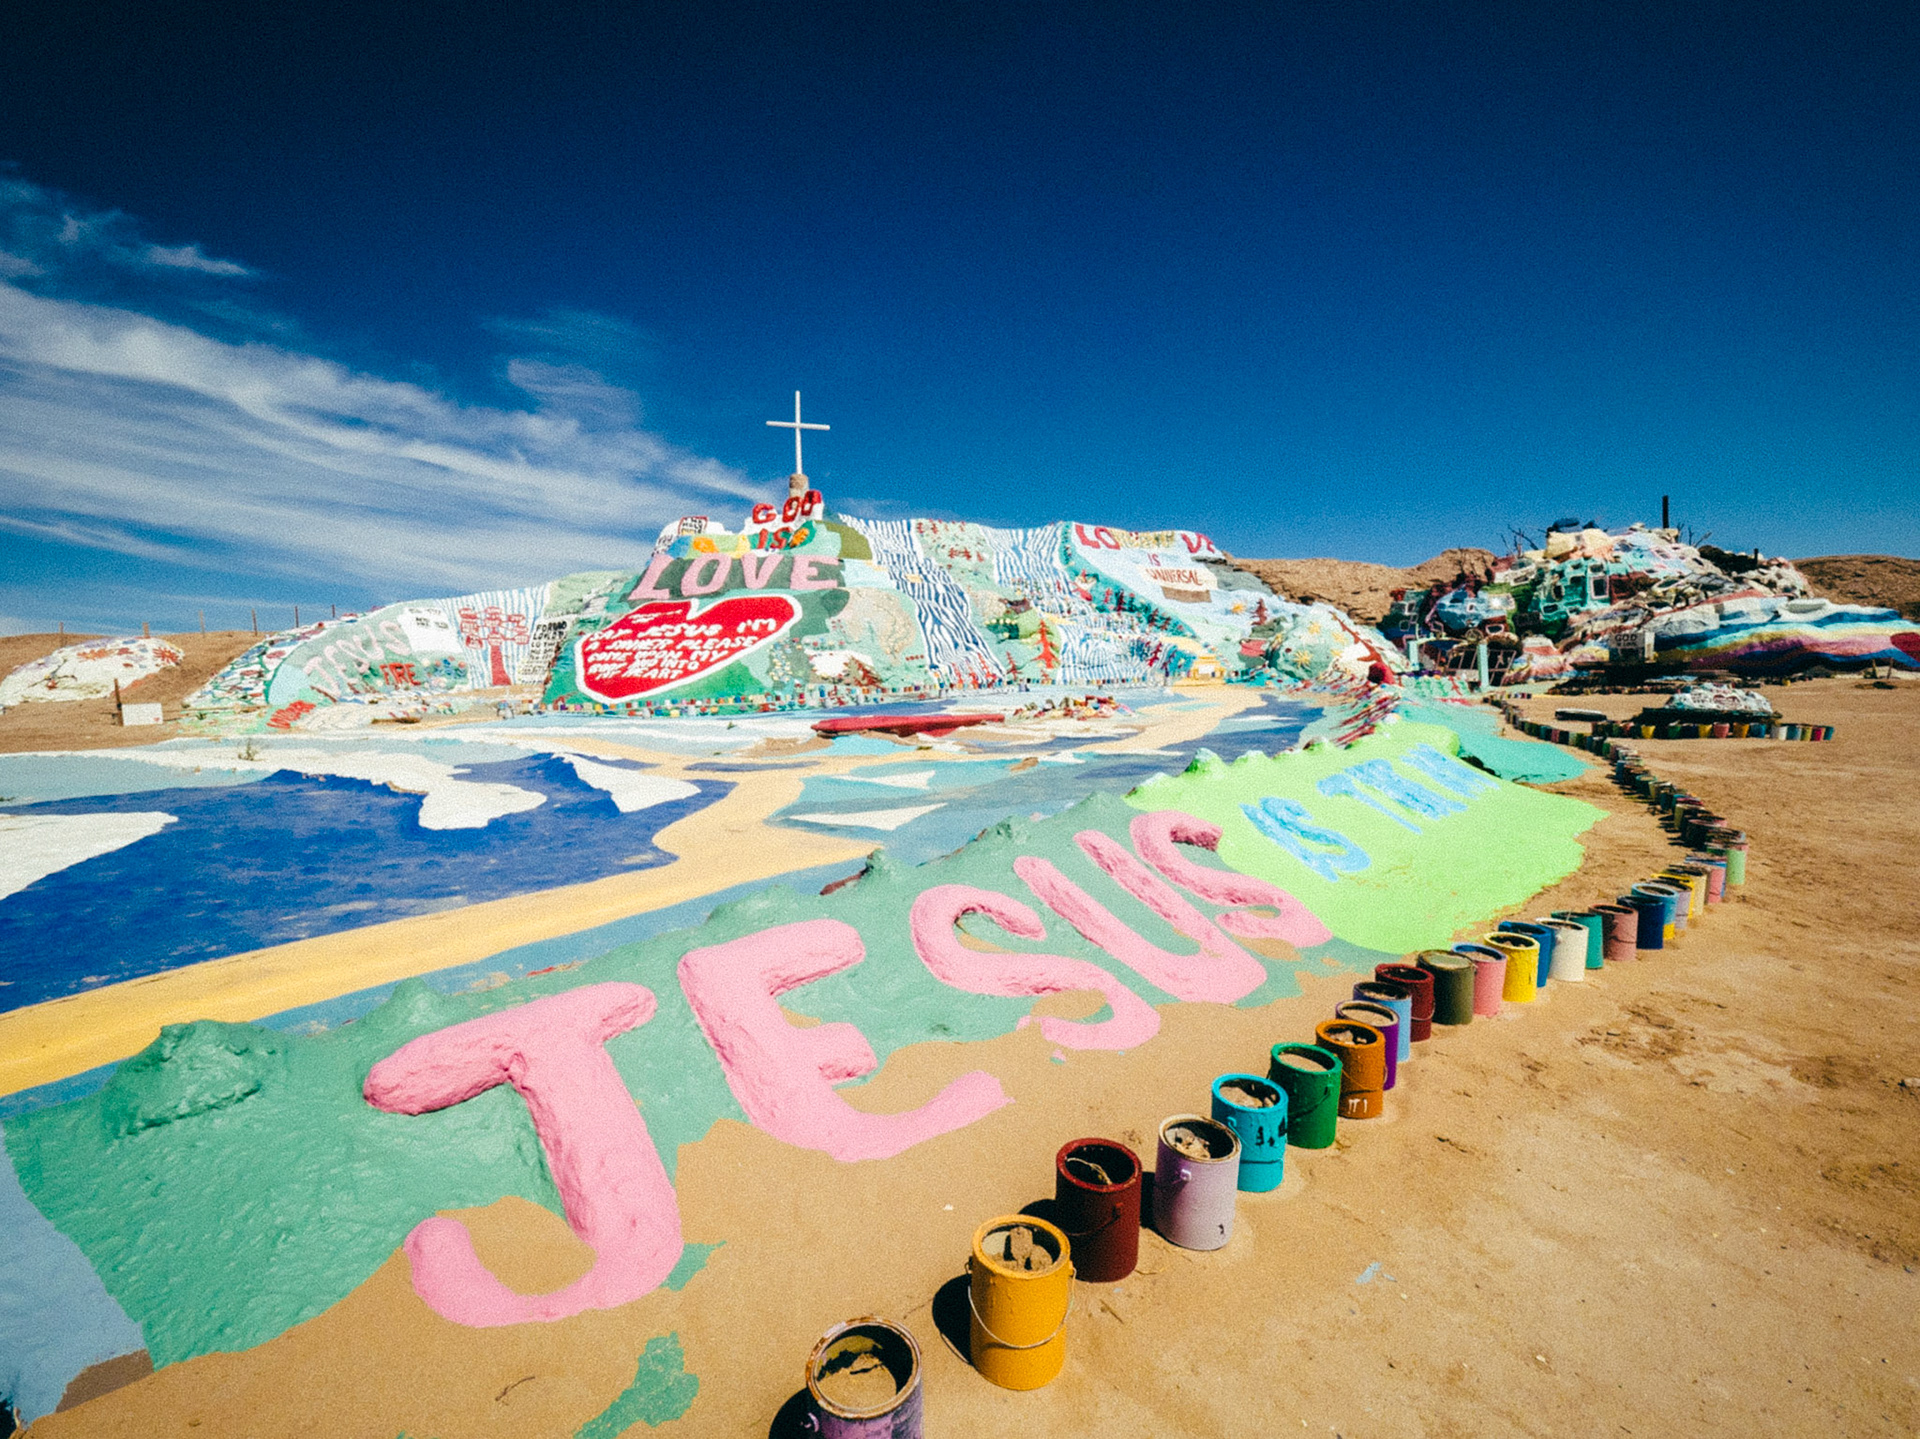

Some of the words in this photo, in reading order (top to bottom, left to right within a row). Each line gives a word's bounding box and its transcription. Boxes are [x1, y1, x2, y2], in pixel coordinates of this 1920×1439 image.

[628, 555, 840, 600] LOVE
[637, 624, 723, 637] JESUS
[676, 635, 758, 650] PLEASE
[689, 650, 729, 663] MY
[364, 809, 1333, 1328] JESUS
